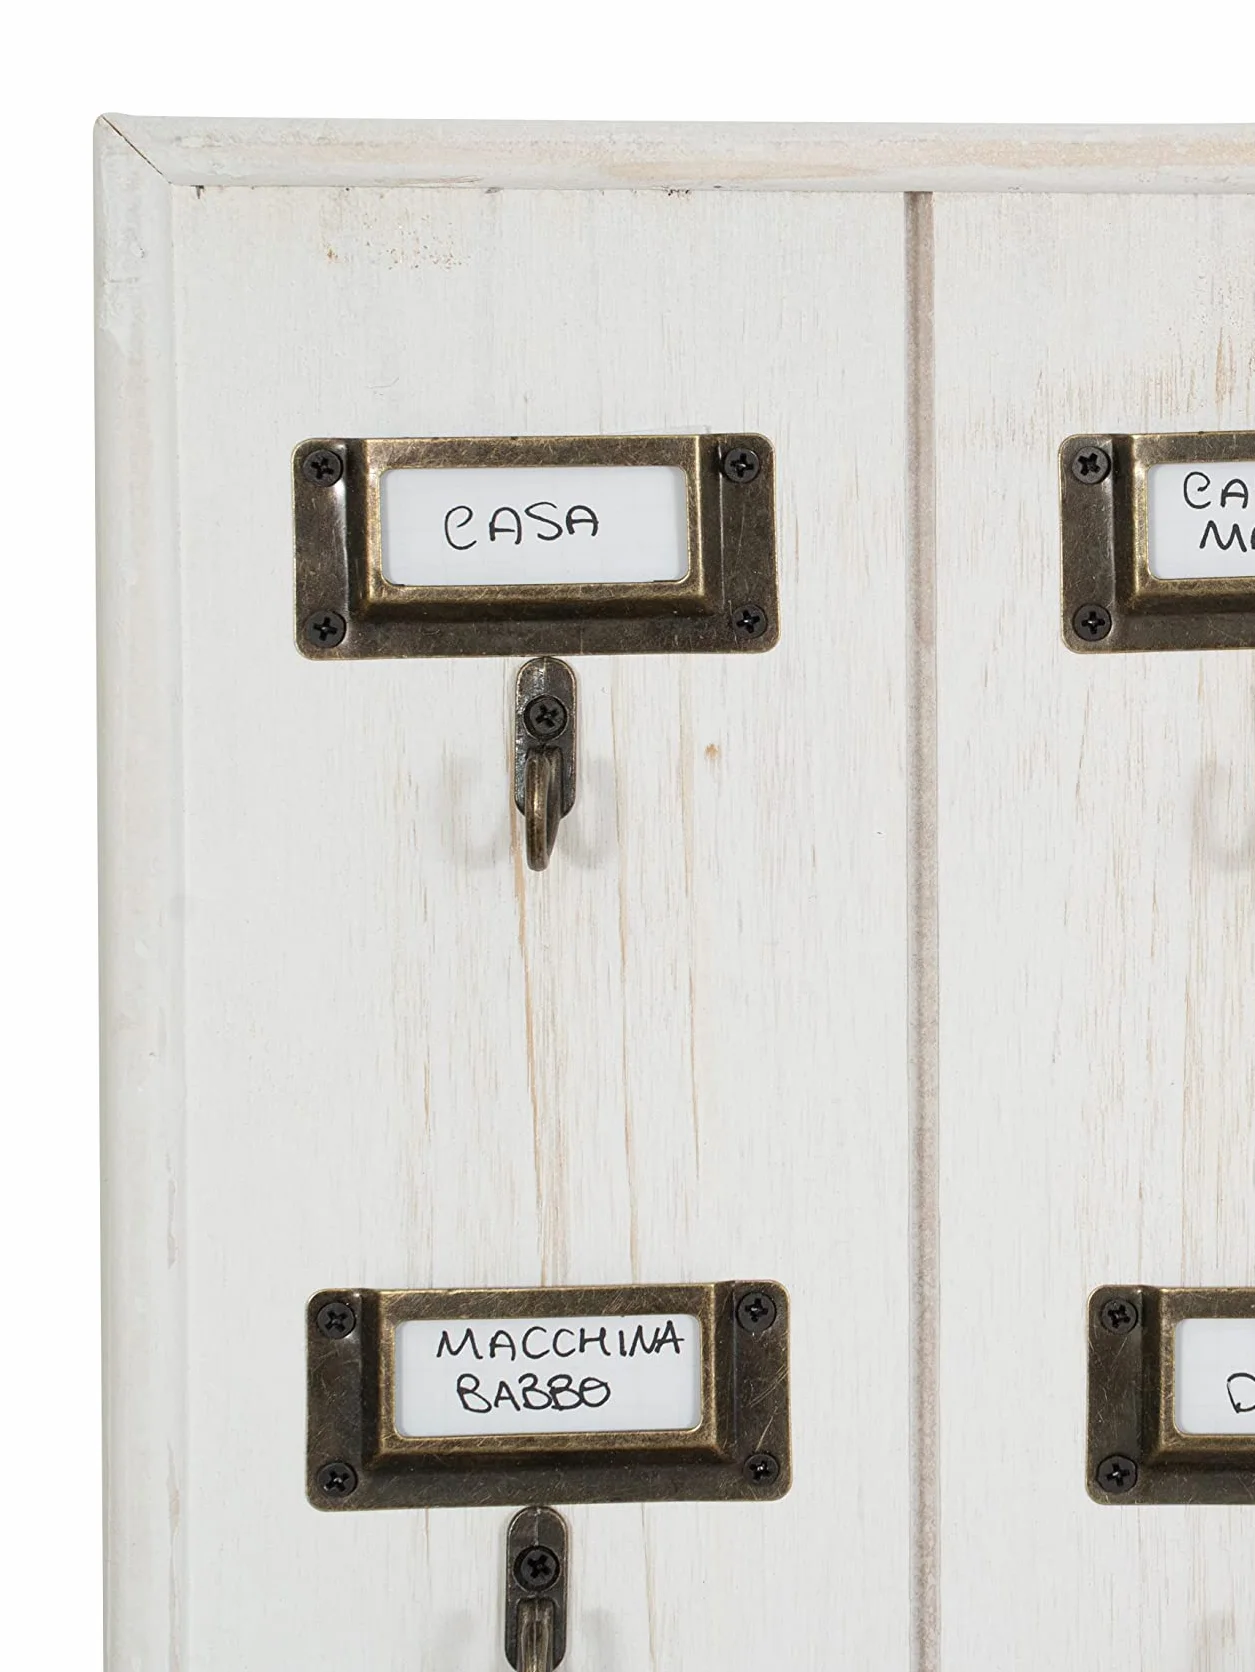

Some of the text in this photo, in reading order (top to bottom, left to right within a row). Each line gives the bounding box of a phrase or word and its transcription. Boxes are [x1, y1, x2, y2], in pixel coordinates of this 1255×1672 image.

[444, 501, 599, 551] CASA
[436, 1321, 685, 1362] MACCHINA
[456, 1372, 611, 1414] BABBO
